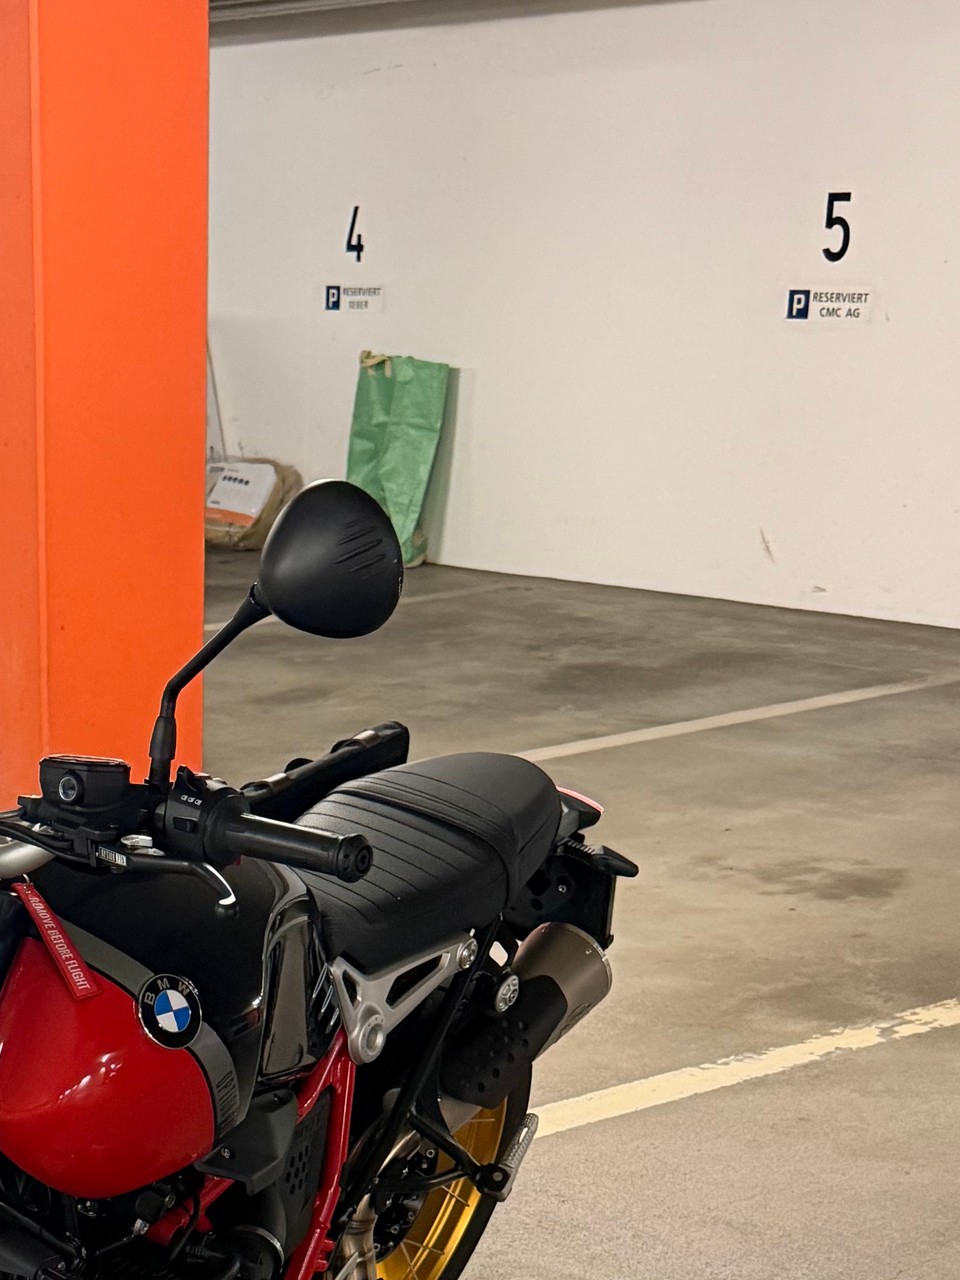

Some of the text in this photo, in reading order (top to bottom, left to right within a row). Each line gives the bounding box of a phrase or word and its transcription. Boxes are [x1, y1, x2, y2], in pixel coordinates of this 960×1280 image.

[346, 206, 364, 262] 4
[822, 192, 851, 262] 5
[328, 288, 339, 309] P
[791, 293, 807, 317] P
[813, 292, 870, 303] RESERVIERT
[819, 307, 860, 318] CMC AG
[29, 897, 91, 989] REMOVE BEFORE FLIGHT
[144, 977, 190, 1006] BMW
